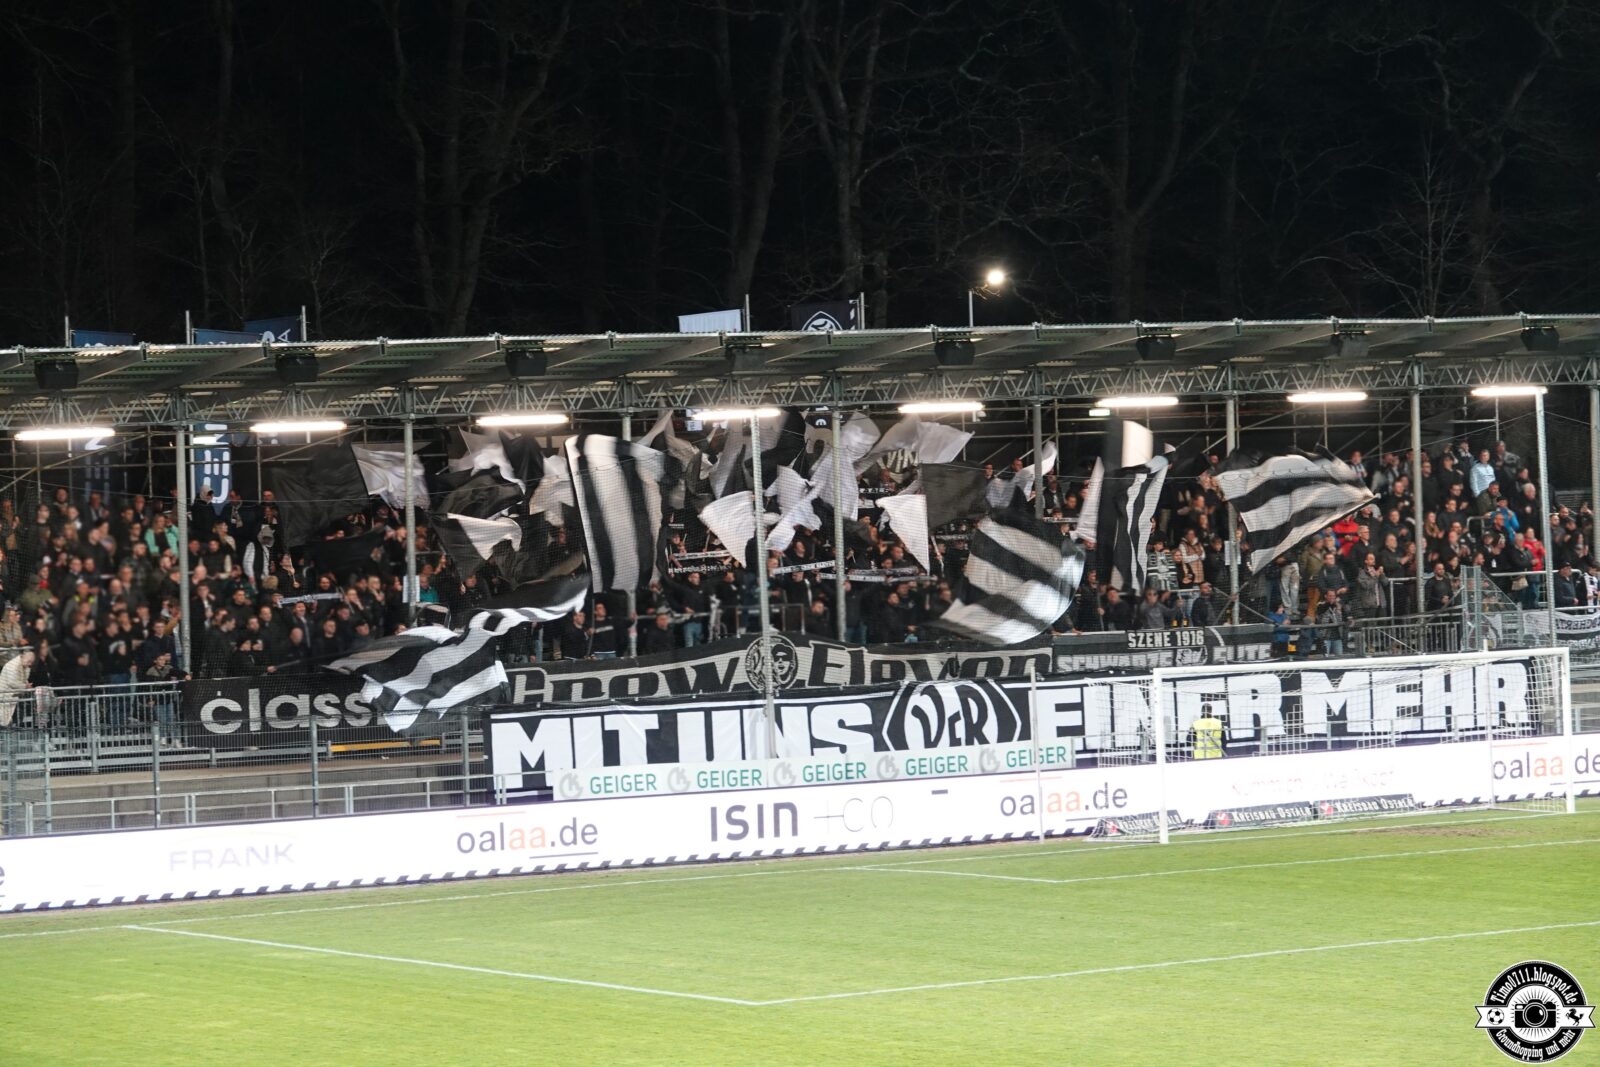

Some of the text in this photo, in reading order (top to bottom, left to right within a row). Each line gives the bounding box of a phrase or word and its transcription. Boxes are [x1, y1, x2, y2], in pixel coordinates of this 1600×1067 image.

[1127, 629, 1205, 648] SZENE 1916
[1212, 642, 1272, 663] ELITE
[491, 713, 660, 790] MIT
[677, 702, 874, 765] UNS
[1028, 673, 1287, 750] EINER
[1301, 662, 1529, 734] MEHR
[590, 746, 1067, 795] GEIGER GEIGER GEIGER GEIGER GEIGER
[456, 817, 598, 854] oalaa.de
[168, 842, 296, 873] FRANK
